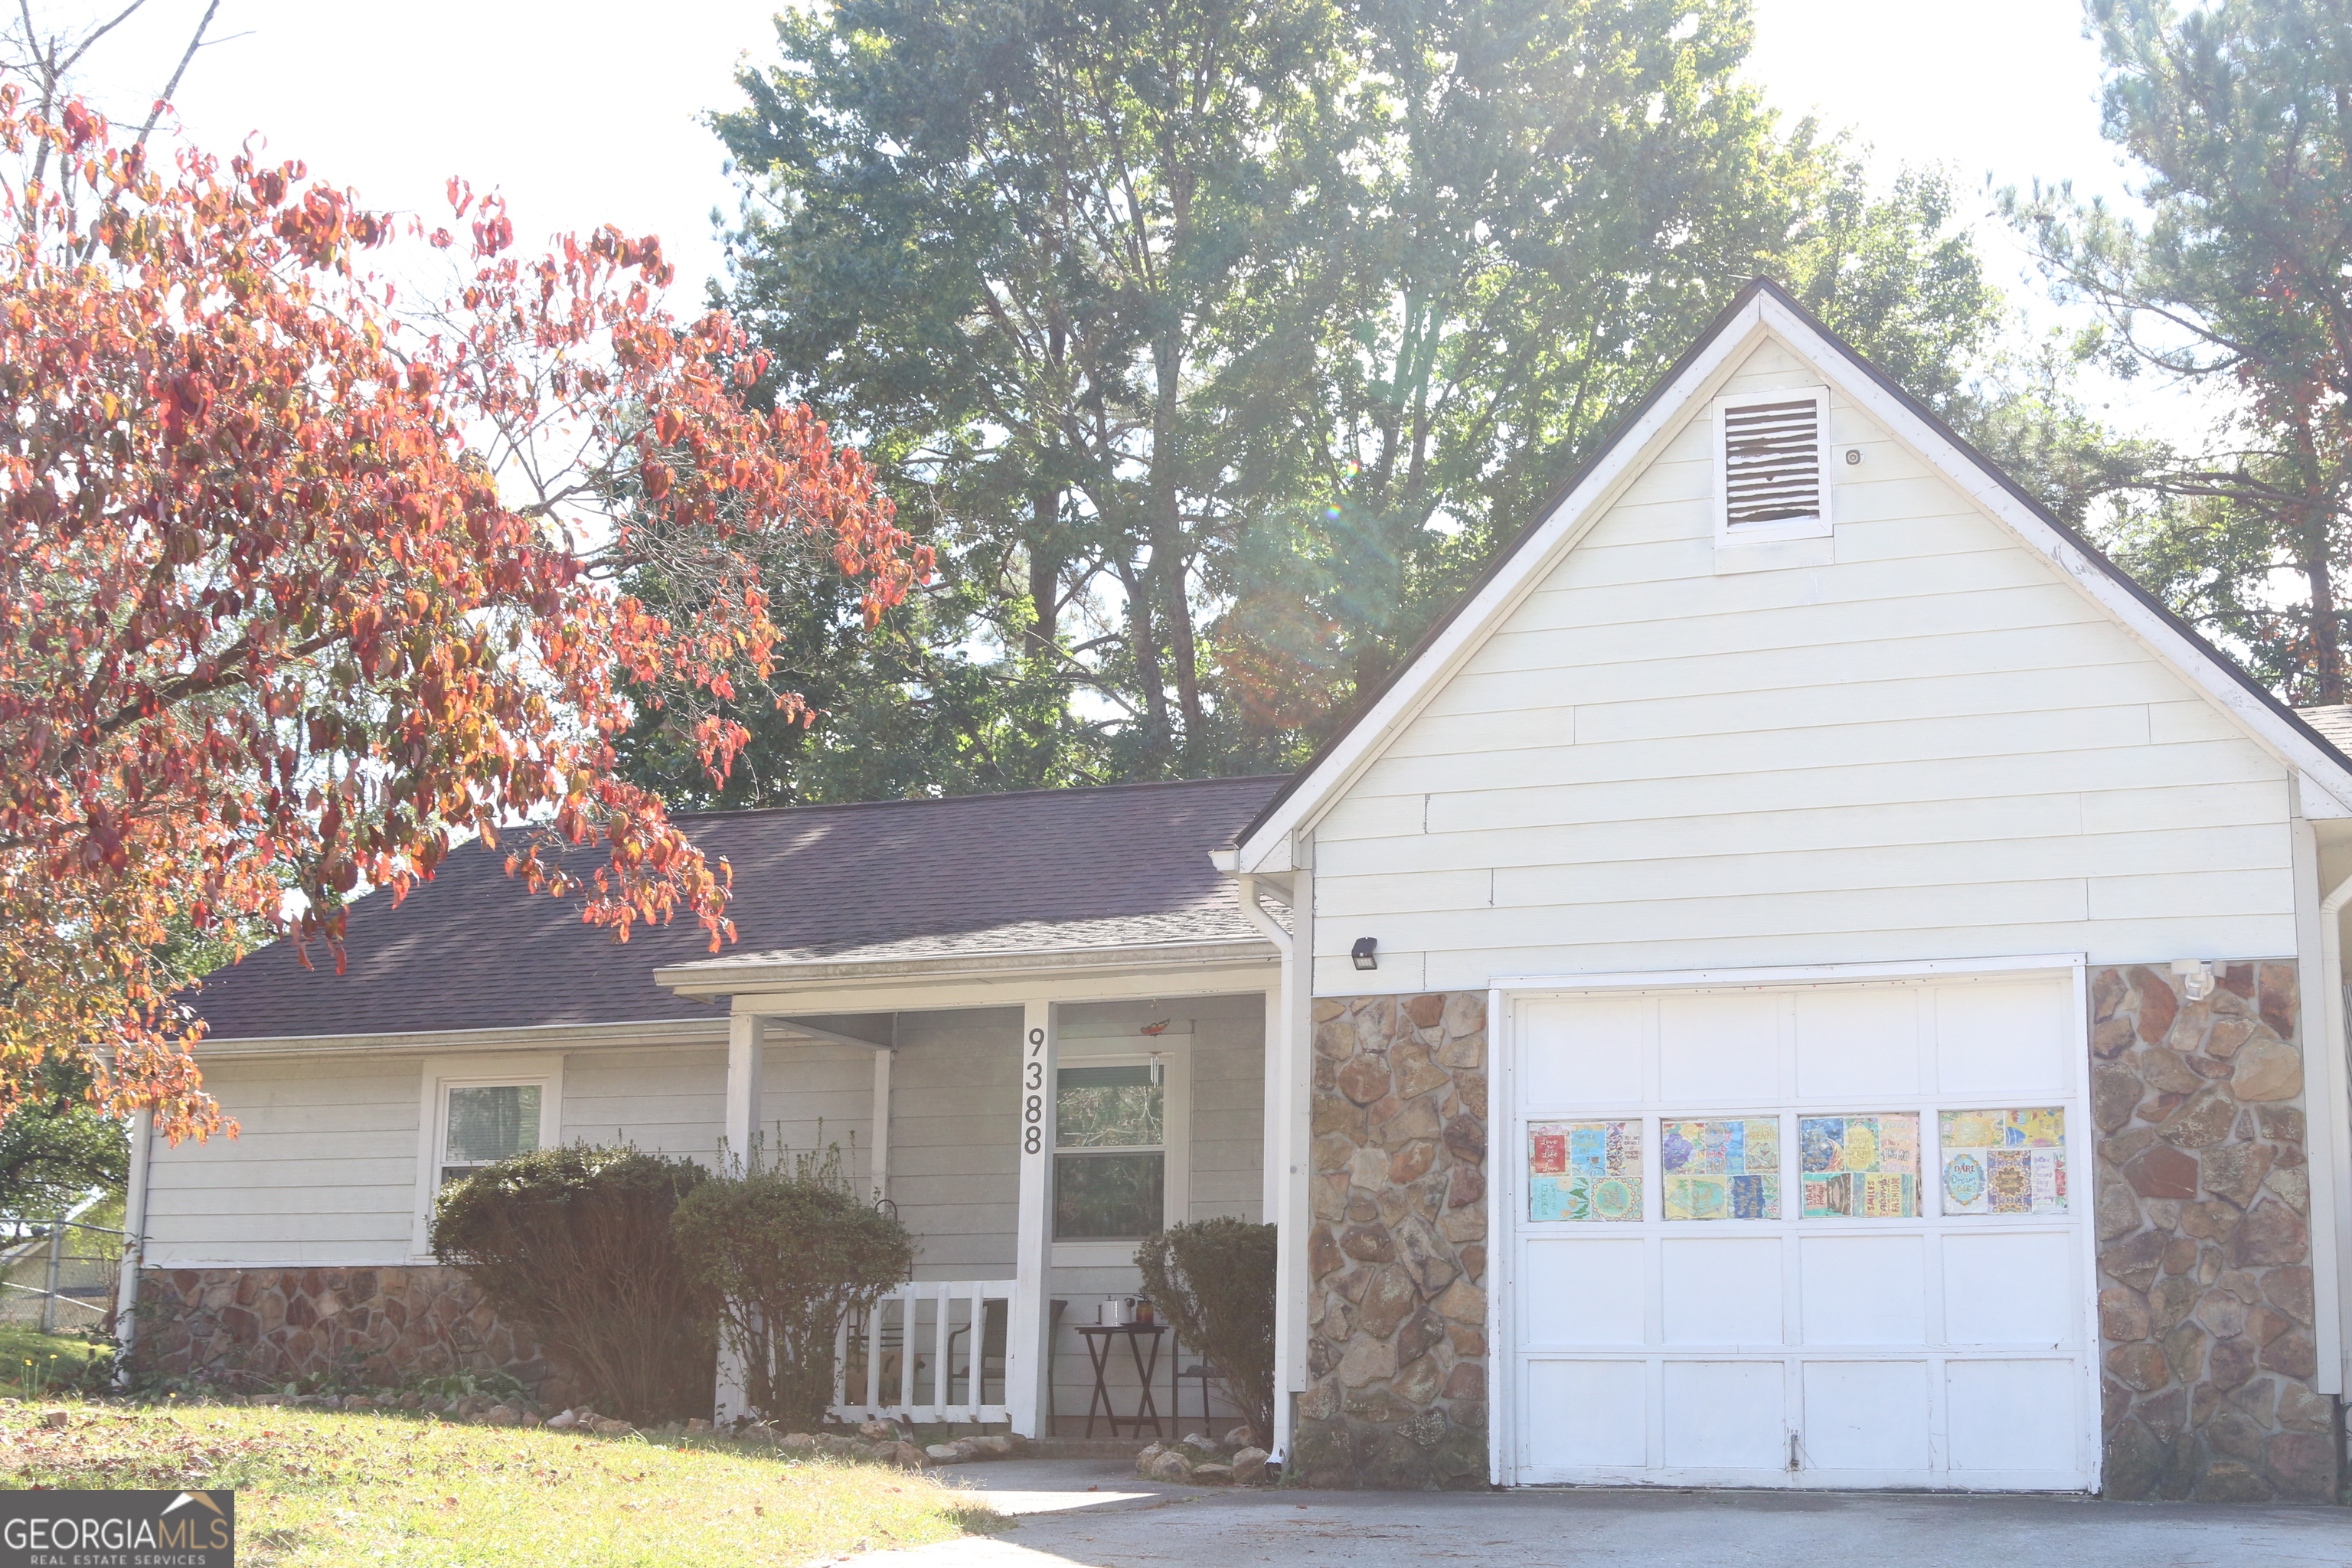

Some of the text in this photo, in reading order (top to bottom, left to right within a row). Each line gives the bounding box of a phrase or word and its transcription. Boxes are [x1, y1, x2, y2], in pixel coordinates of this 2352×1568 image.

[1024, 1027, 1044, 1155] 9388
[1540, 1138, 1558, 1146] Love
[1541, 1149, 1558, 1158] Life
[1541, 1162, 1560, 1172] Live
[1954, 1164, 1975, 1174] DARE
[1952, 1174, 1977, 1184] Dream
[1878, 1179, 1890, 1212] always
[1891, 1178, 1900, 1213] FASHION
